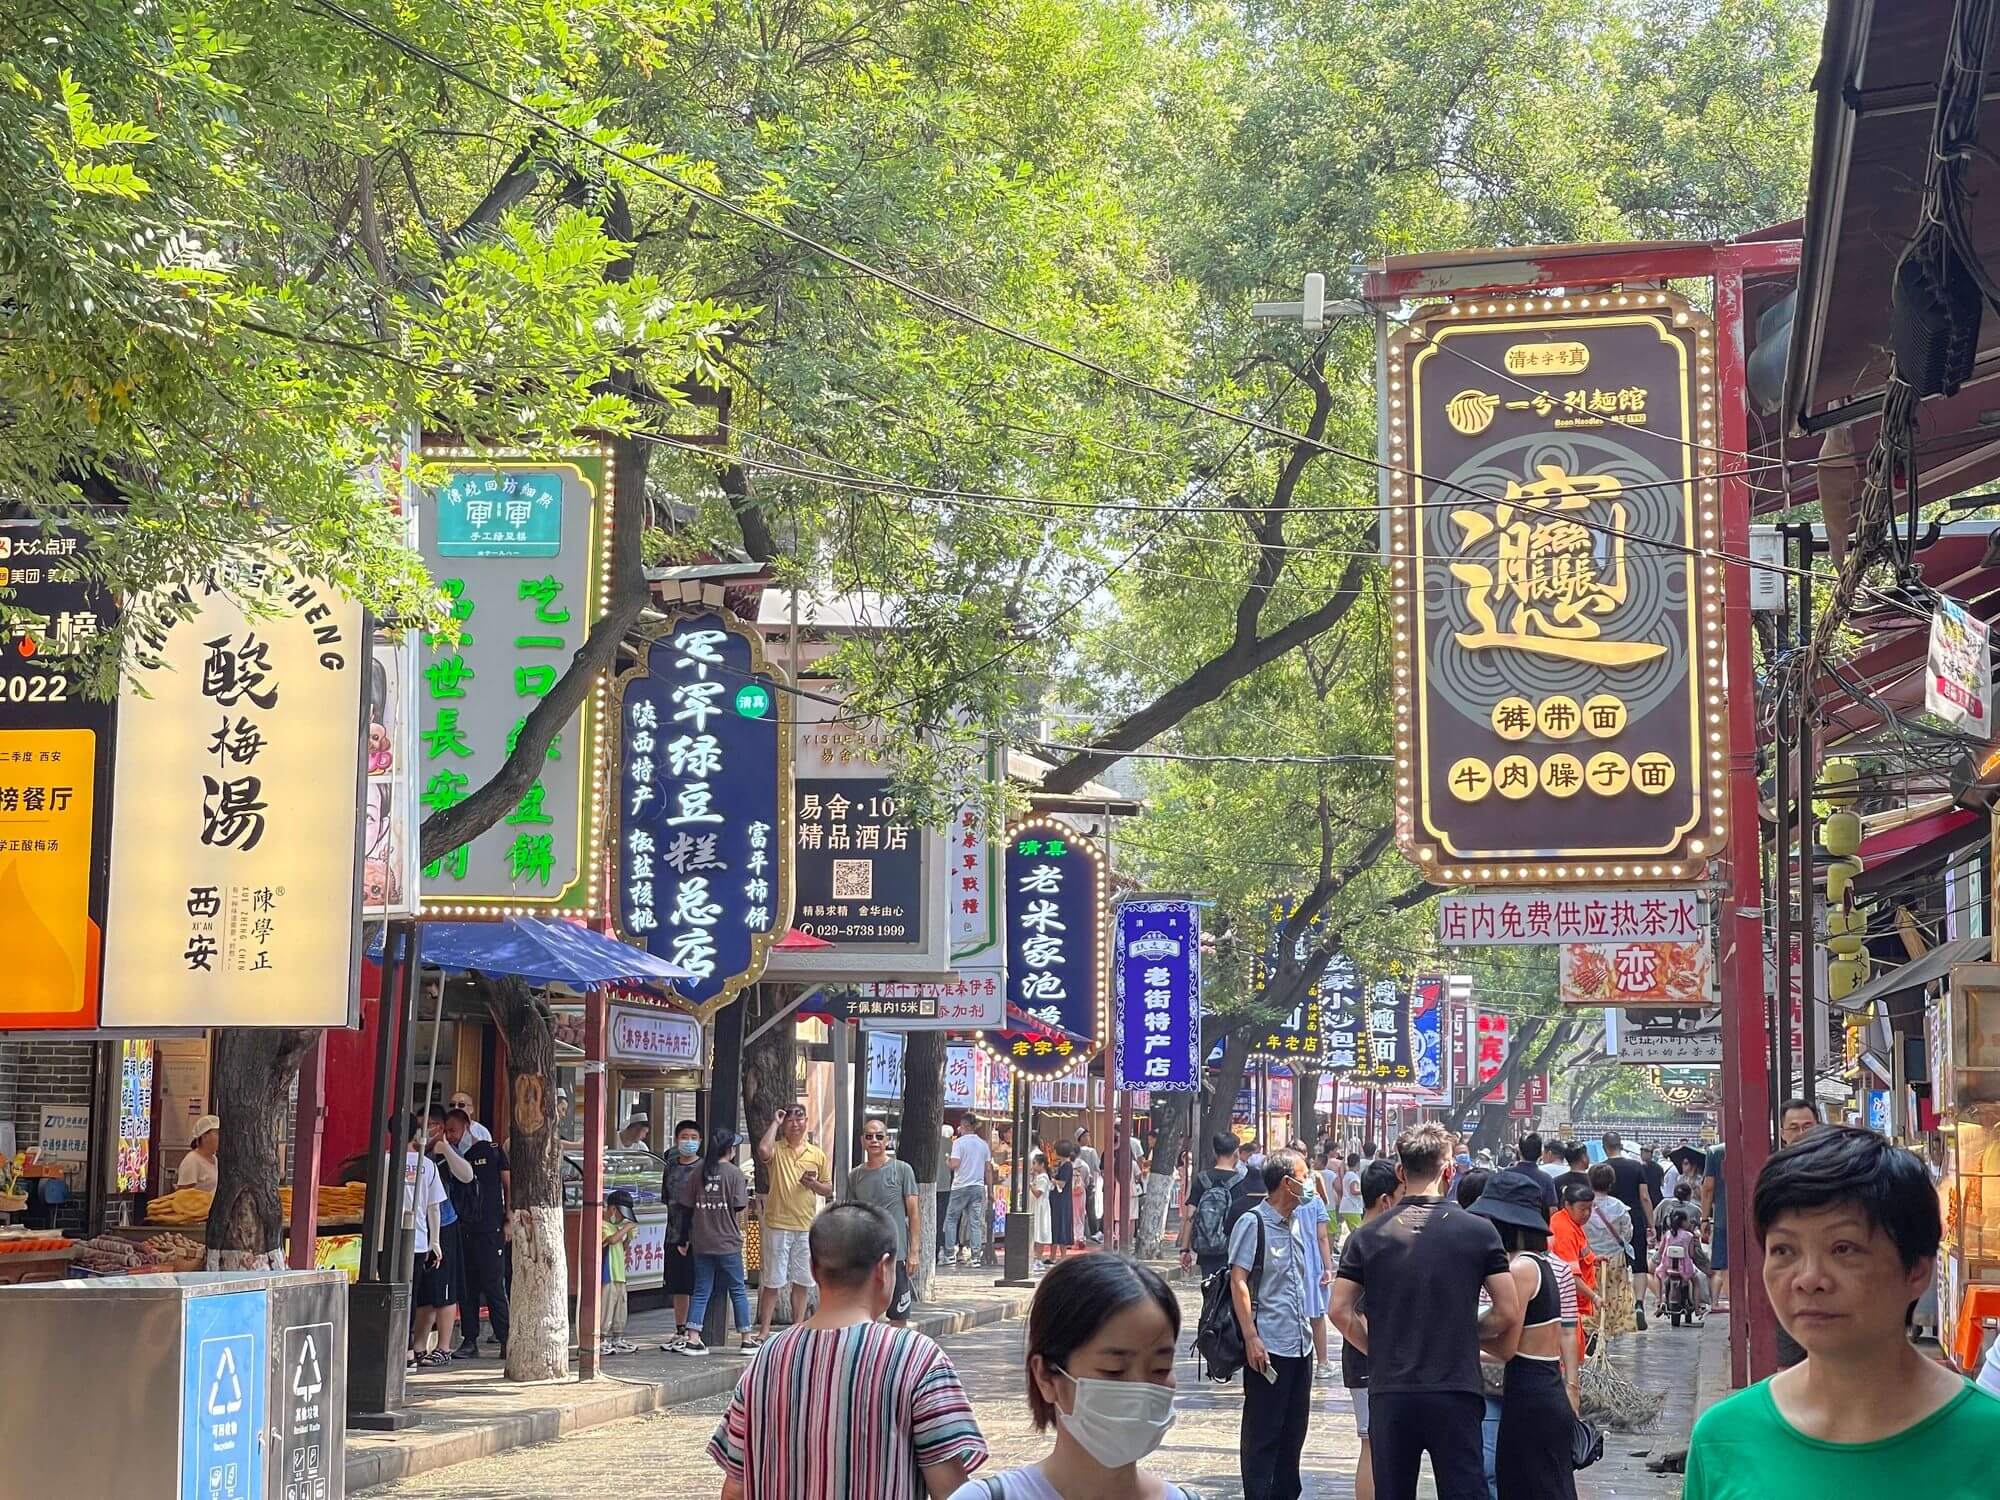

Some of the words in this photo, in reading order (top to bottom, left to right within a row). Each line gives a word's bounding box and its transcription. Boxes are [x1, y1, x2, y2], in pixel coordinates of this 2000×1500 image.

[13, 538, 77, 555] 大众点评
[283, 574, 345, 671] HENG
[738, 694, 766, 709] 清真
[1497, 703, 1622, 733] 裤带面
[199, 631, 280, 852] 酸梅湯
[40, 751, 61, 762] 西安
[630, 699, 658, 817] 陕西特产
[1454, 758, 1672, 793] 牛肉臊子面
[798, 823, 909, 851] 精品酒店
[1019, 839, 1068, 857] 清真
[628, 828, 658, 932] 椒盐核桃
[744, 820, 770, 932] 富平柿饼
[239, 911, 248, 940] ZHENG
[803, 905, 848, 917] 精易求精
[1441, 898, 1698, 940] 店内免费供应热茶水
[184, 886, 221, 972] 西安
[250, 886, 276, 971] 陳學正
[817, 925, 874, 936] 029-8738
[877, 925, 905, 936] 1999
[238, 948, 247, 970] CHEN
[1615, 946, 1658, 993] 恋
[846, 1001, 918, 1014] 子佩集内15米
[1143, 966, 1171, 1077] 老街特产店
[1012, 1040, 1074, 1056] 老字号
[45, 1115, 65, 1128] ZTO
[42, 1139, 87, 1152] 中通快递代理点
